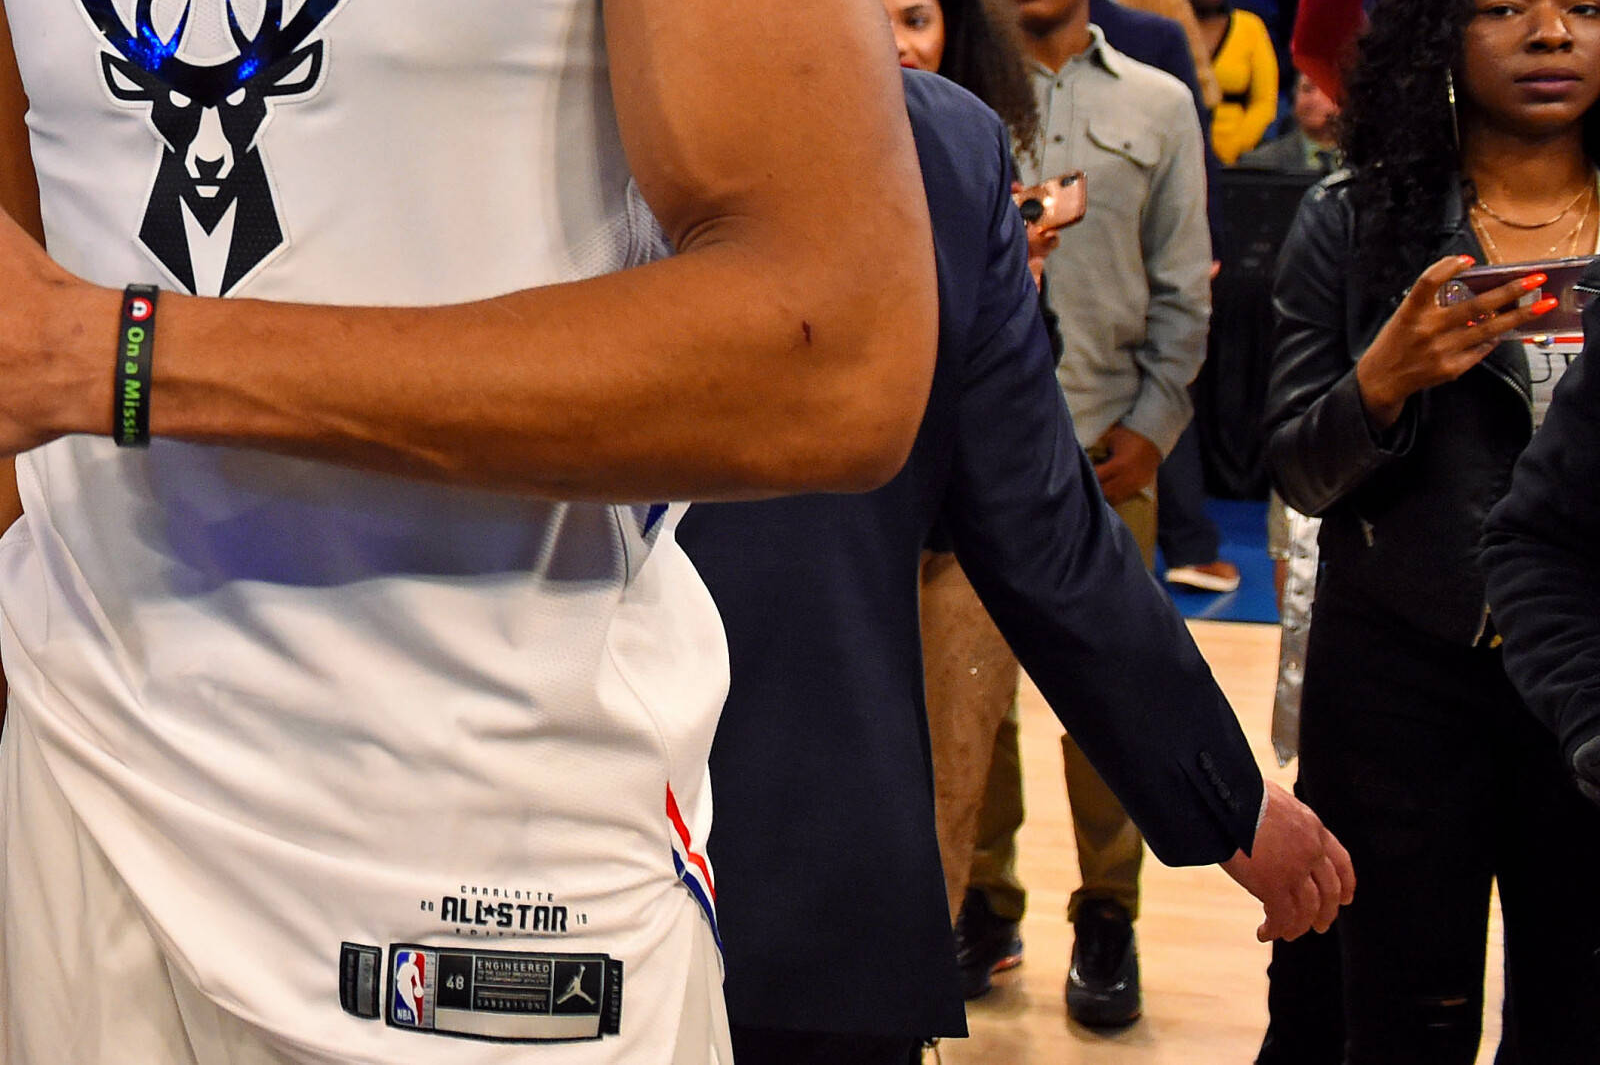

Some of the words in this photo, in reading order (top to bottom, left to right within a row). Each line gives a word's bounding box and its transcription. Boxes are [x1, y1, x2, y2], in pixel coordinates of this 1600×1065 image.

[461, 885, 553, 903] CHARLOTTE
[477, 960, 550, 974] ENGINEERED
[446, 975, 465, 991] 48
[397, 1006, 412, 1021] NBA
